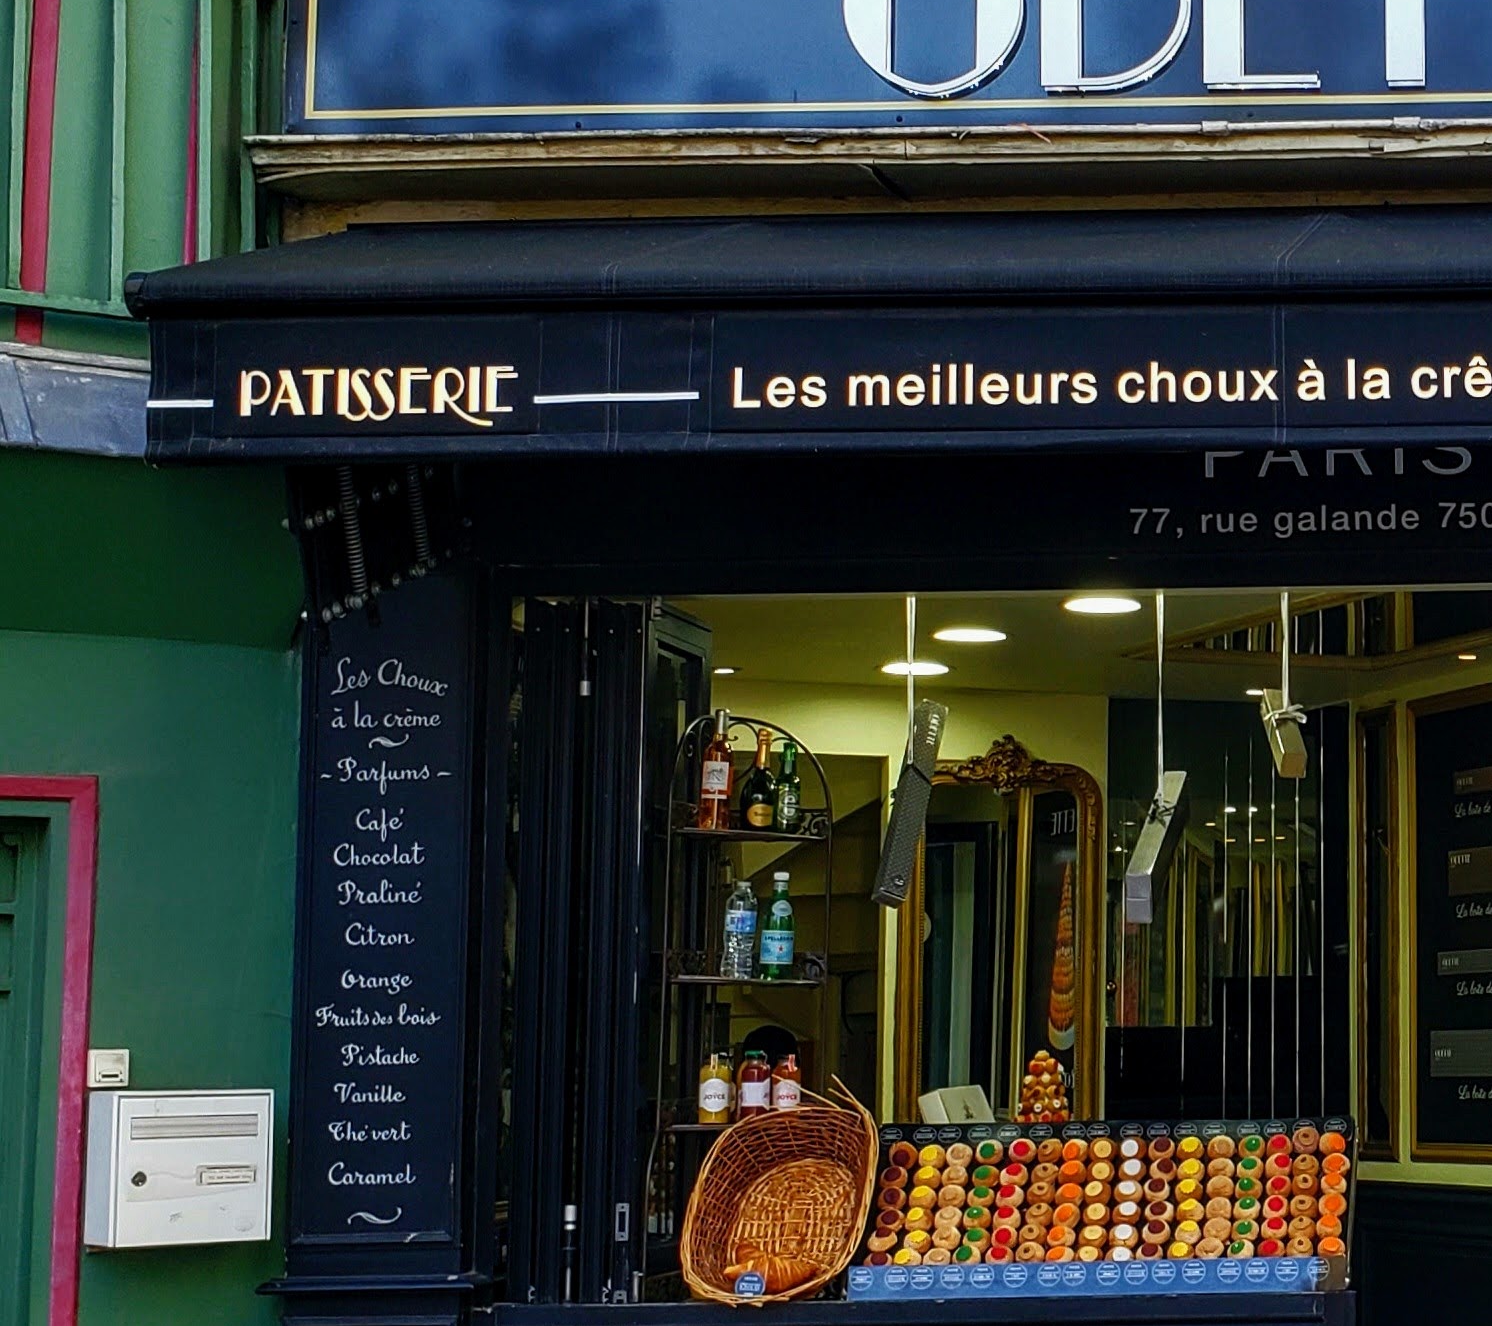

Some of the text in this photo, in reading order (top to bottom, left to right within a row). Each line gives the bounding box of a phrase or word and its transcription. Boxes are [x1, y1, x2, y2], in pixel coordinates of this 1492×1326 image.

[239, 365, 518, 427] PATISSERIE
[731, 366, 828, 409] Les
[848, 363, 1098, 407] meilleurs
[1116, 361, 1279, 404] choux
[1297, 358, 1326, 402] à
[1347, 358, 1391, 401] la
[1129, 509, 1184, 538] 77,
[1201, 511, 1258, 534] rue
[1273, 504, 1420, 539] galande
[331, 657, 448, 698] Les Choux
[332, 701, 441, 729] à la crème
[337, 757, 431, 795] Parfums
[355, 809, 404, 842] Café
[333, 843, 425, 868] Chocolat
[337, 880, 423, 905] Praliné
[345, 923, 415, 948] Citron
[341, 970, 413, 994] Orange
[315, 1005, 369, 1027] Fruits
[398, 1003, 441, 1026] bois
[340, 1044, 420, 1067] Pistache
[334, 1082, 406, 1104] Vanille
[328, 1121, 412, 1141] Thé vert
[327, 1161, 416, 1186] Caramel
